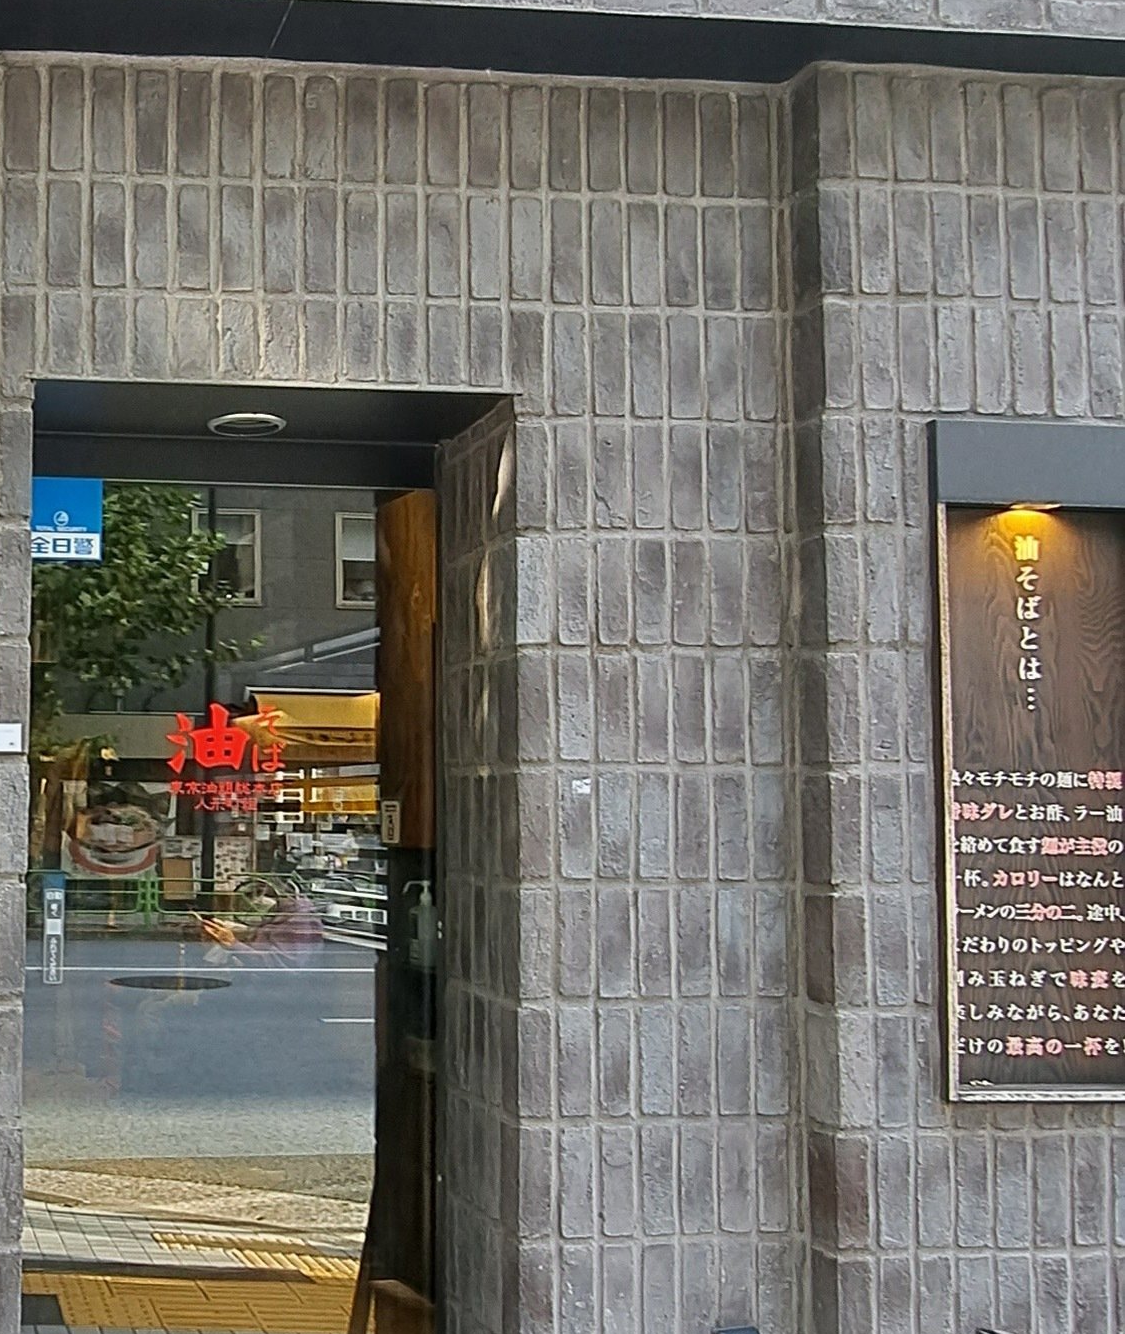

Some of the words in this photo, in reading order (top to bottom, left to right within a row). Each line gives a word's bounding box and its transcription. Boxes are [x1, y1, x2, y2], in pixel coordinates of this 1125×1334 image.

[30, 536, 94, 555] 全日警
[956, 902, 1125, 922] ーメンの三分の二。途中、
[956, 935, 1125, 955] だわりのトッピングや
